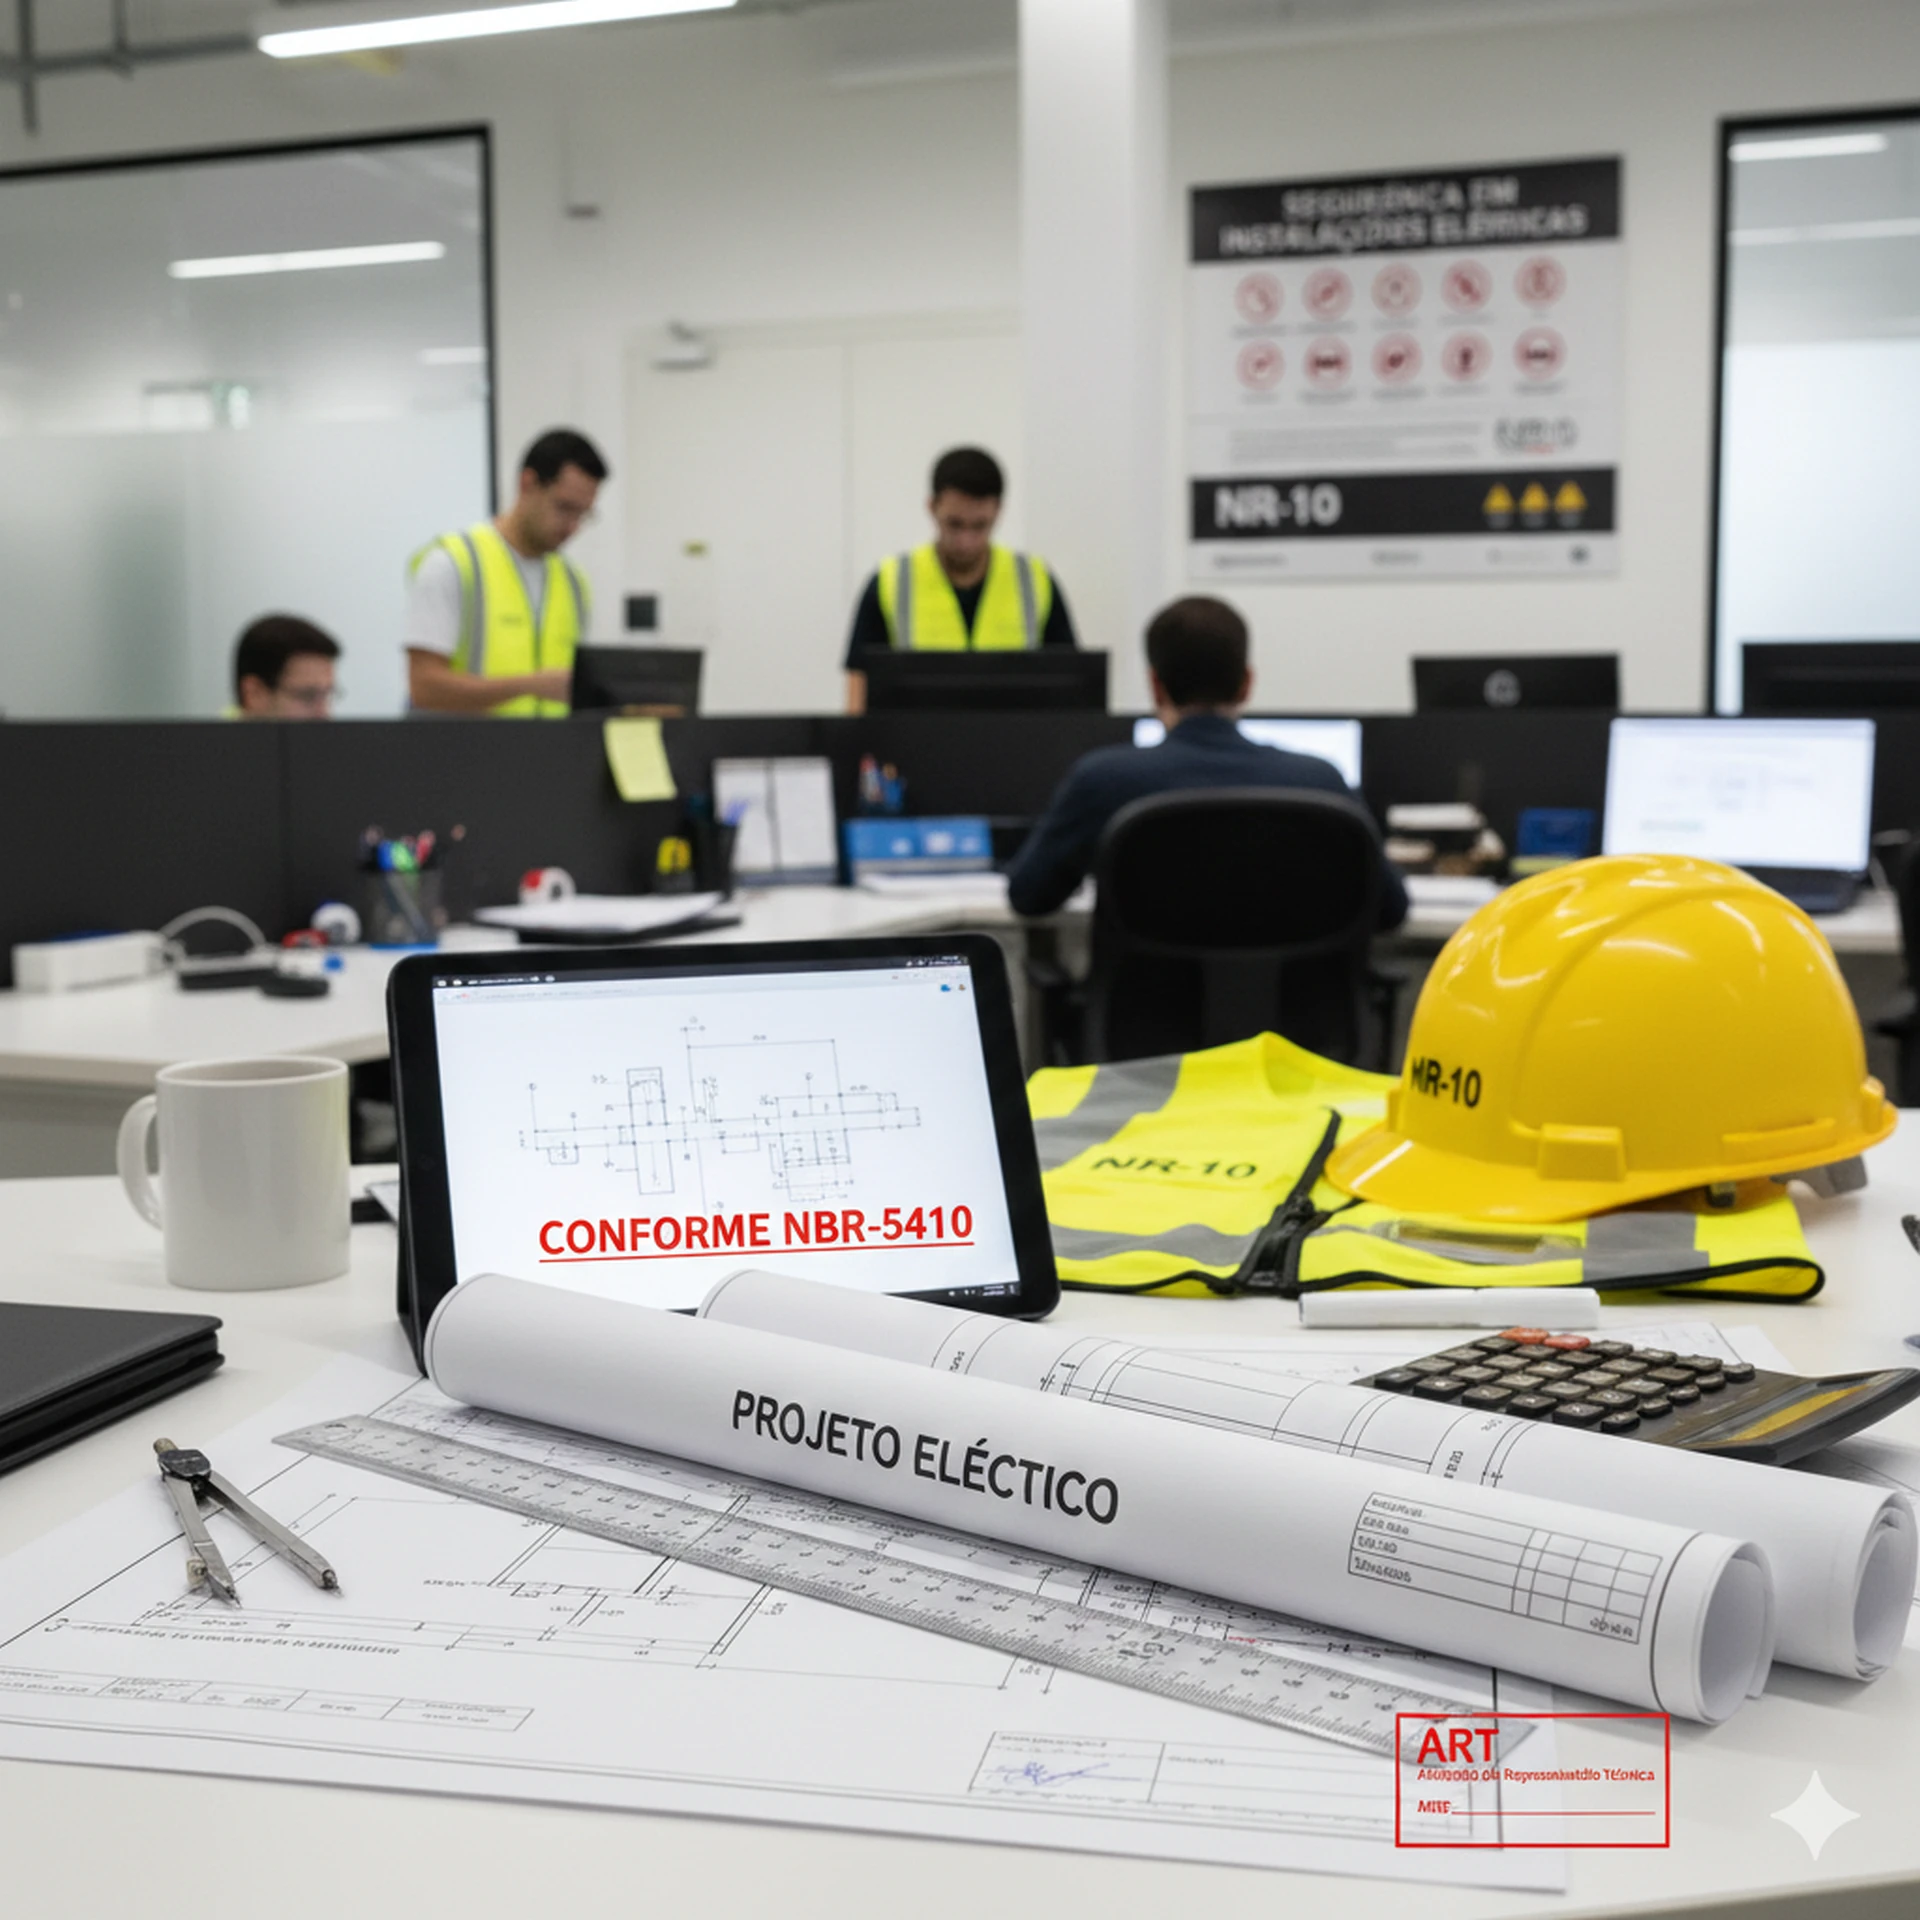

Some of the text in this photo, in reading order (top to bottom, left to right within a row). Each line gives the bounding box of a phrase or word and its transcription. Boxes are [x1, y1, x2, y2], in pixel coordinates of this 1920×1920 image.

[1214, 483, 1343, 529] NR-10
[1091, 1155, 1257, 1180] NR-10
[539, 1204, 974, 1255] CONFORME NBR-5410
[732, 1389, 1119, 1525] PROJETO ELÉCTICO
